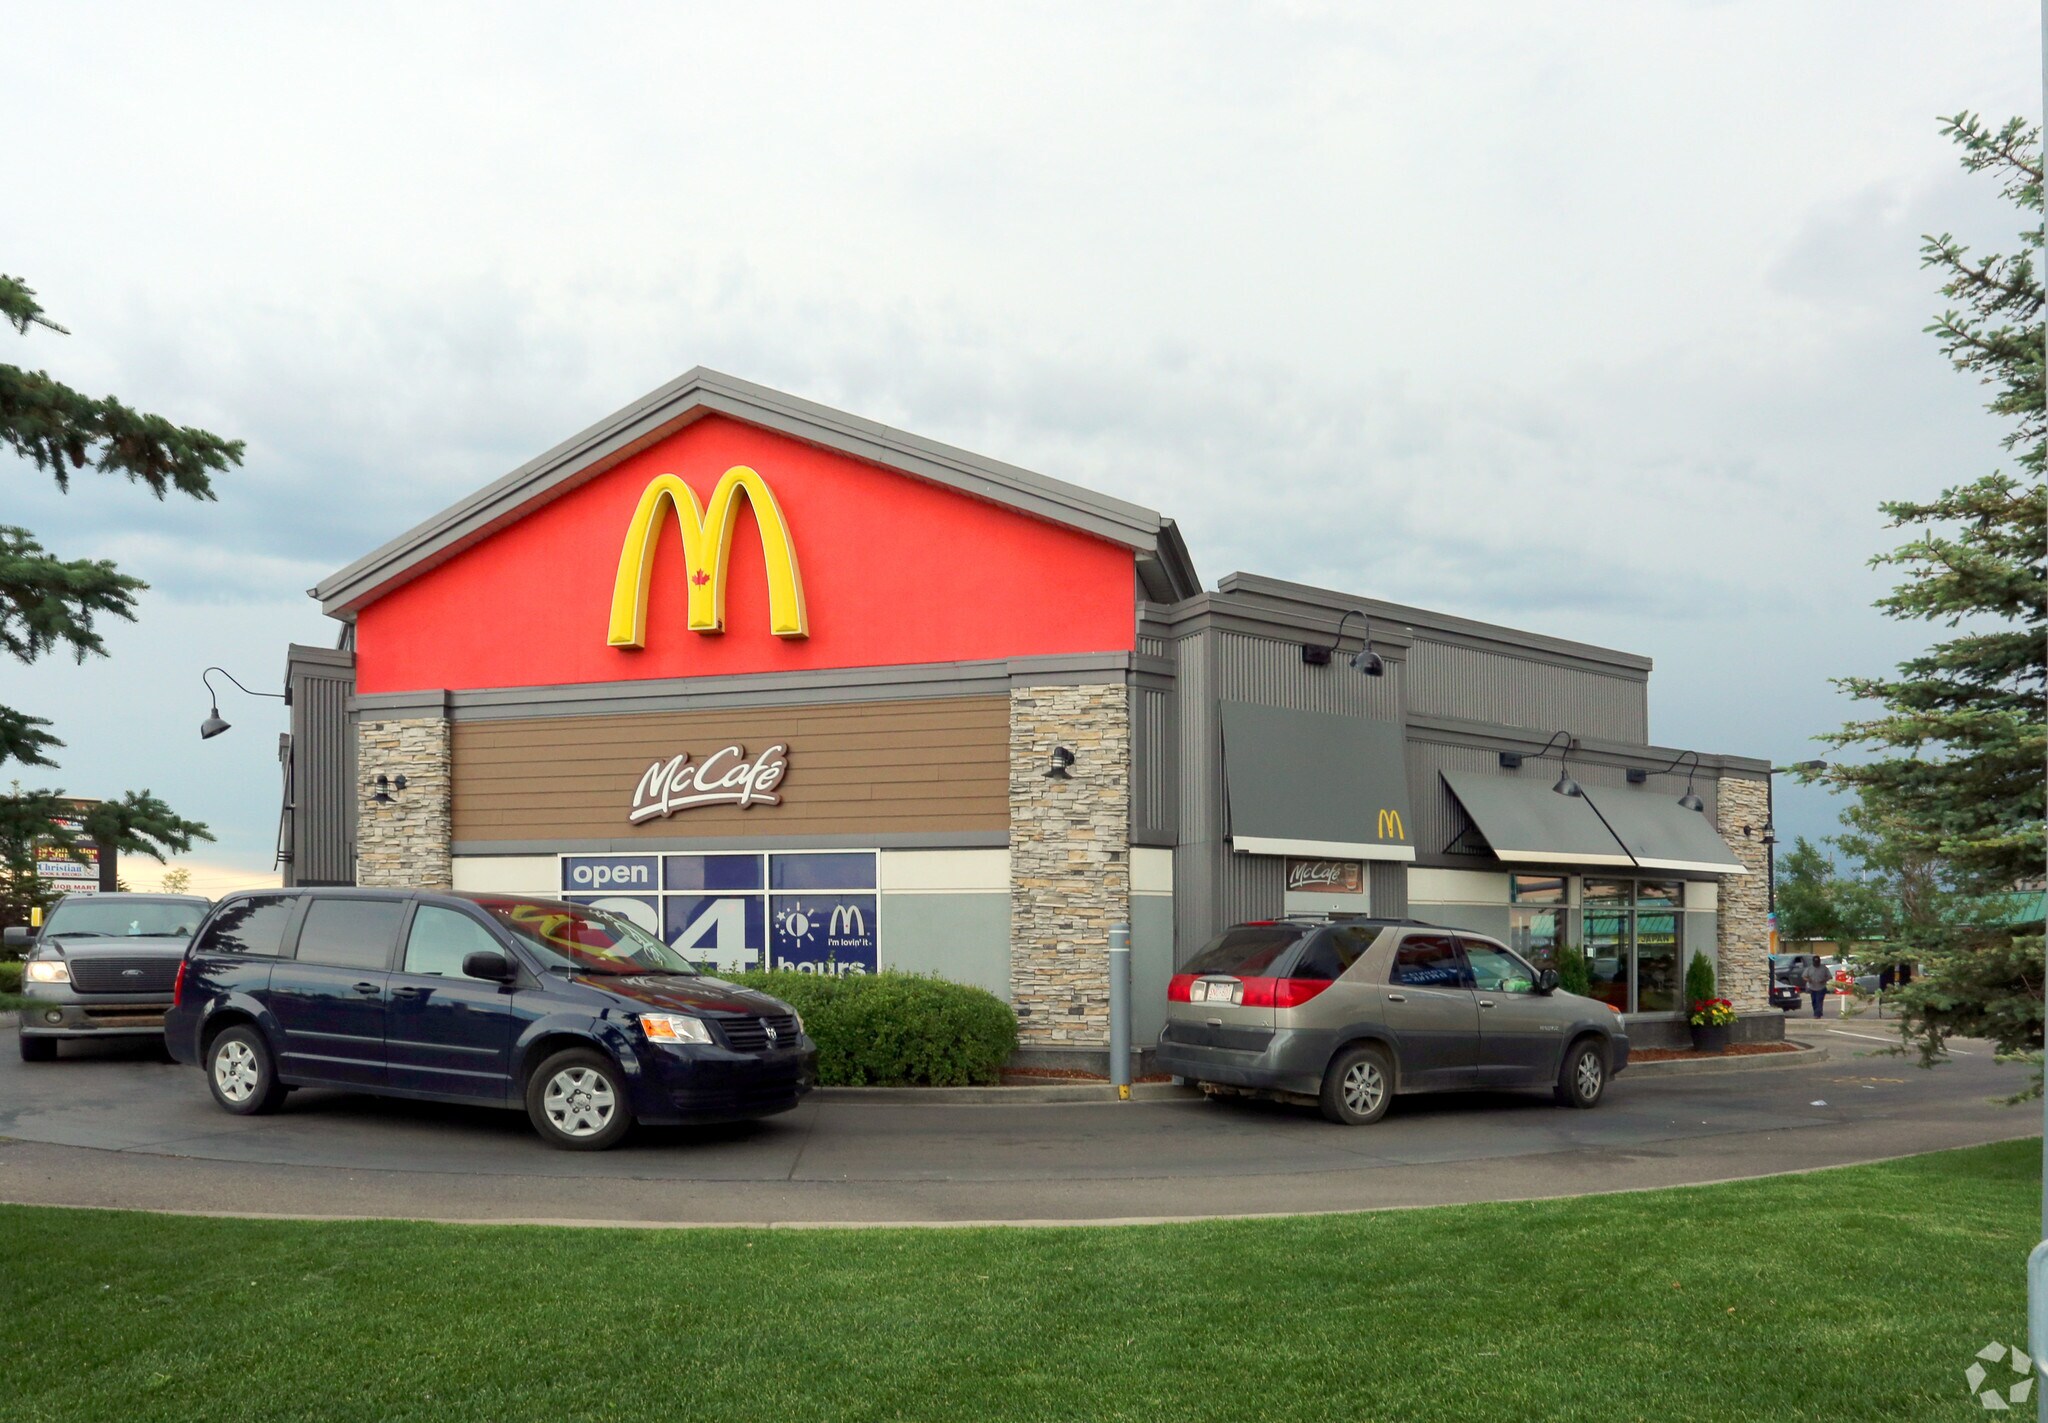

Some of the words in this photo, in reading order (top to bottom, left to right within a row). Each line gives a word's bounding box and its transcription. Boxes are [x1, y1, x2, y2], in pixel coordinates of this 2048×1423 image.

[630, 745, 783, 818] McCafé
[38, 863, 82, 872] Christian
[573, 865, 649, 888] open
[1289, 862, 1341, 887] McCafé
[841, 938, 861, 946] lovin'
[862, 938, 869, 946] it
